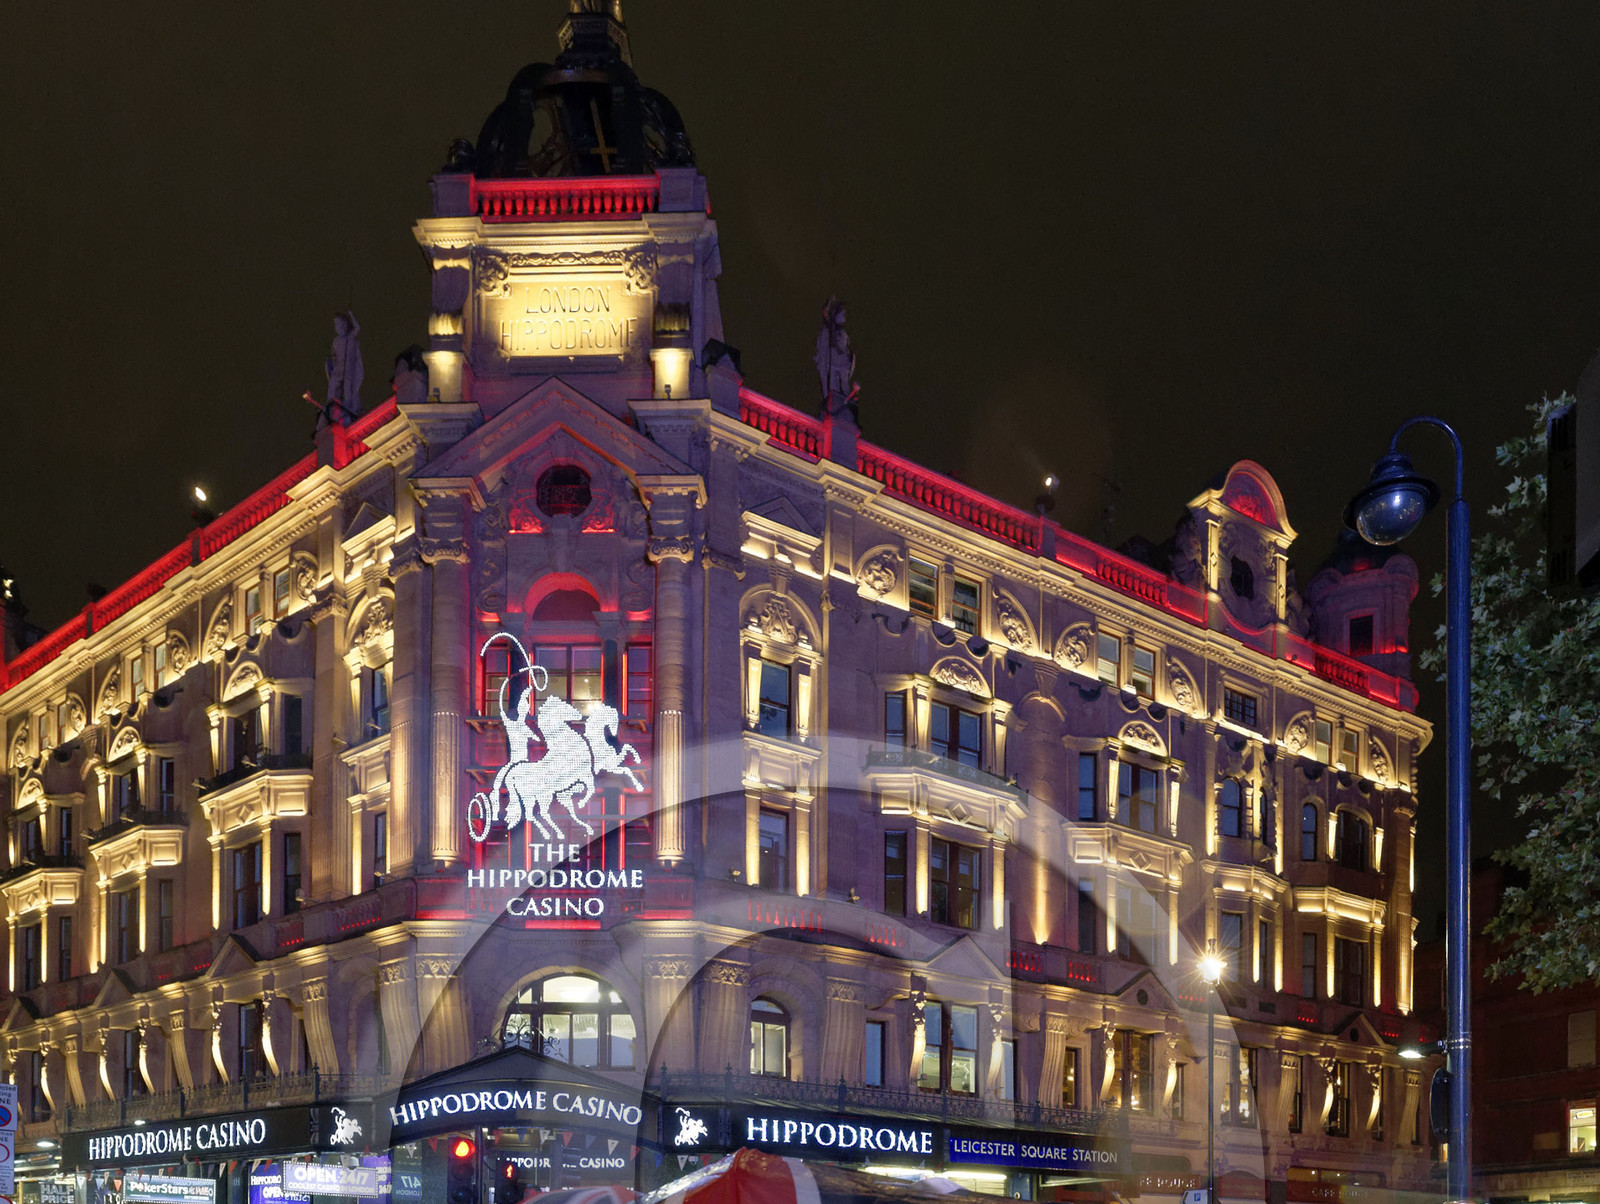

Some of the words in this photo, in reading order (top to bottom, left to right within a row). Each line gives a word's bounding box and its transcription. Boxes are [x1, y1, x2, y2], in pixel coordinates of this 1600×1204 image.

[525, 286, 610, 314] LONDON
[500, 315, 638, 351] HIPPODROME
[529, 843, 581, 863] THE
[467, 868, 644, 889] HIPPODROME
[506, 897, 605, 917] CASINO
[389, 1090, 547, 1126] HIPPODROME
[552, 1093, 643, 1126] CASINO
[88, 1126, 193, 1161] HIPPODROME
[195, 1118, 266, 1150] CASINO
[746, 1117, 933, 1154] HIPPODROME
[953, 1139, 1016, 1157] LEICESTER
[1021, 1144, 1068, 1161] SQUARE
[1072, 1148, 1118, 1164] STATION
[579, 1157, 625, 1168] CASINO
[294, 1166, 338, 1182] OPEN
[339, 1169, 370, 1185] 24/7
[40, 1184, 74, 1194] HALF
[348, 1185, 374, 1193] LONDON
[40, 1195, 75, 1204] PRICE
